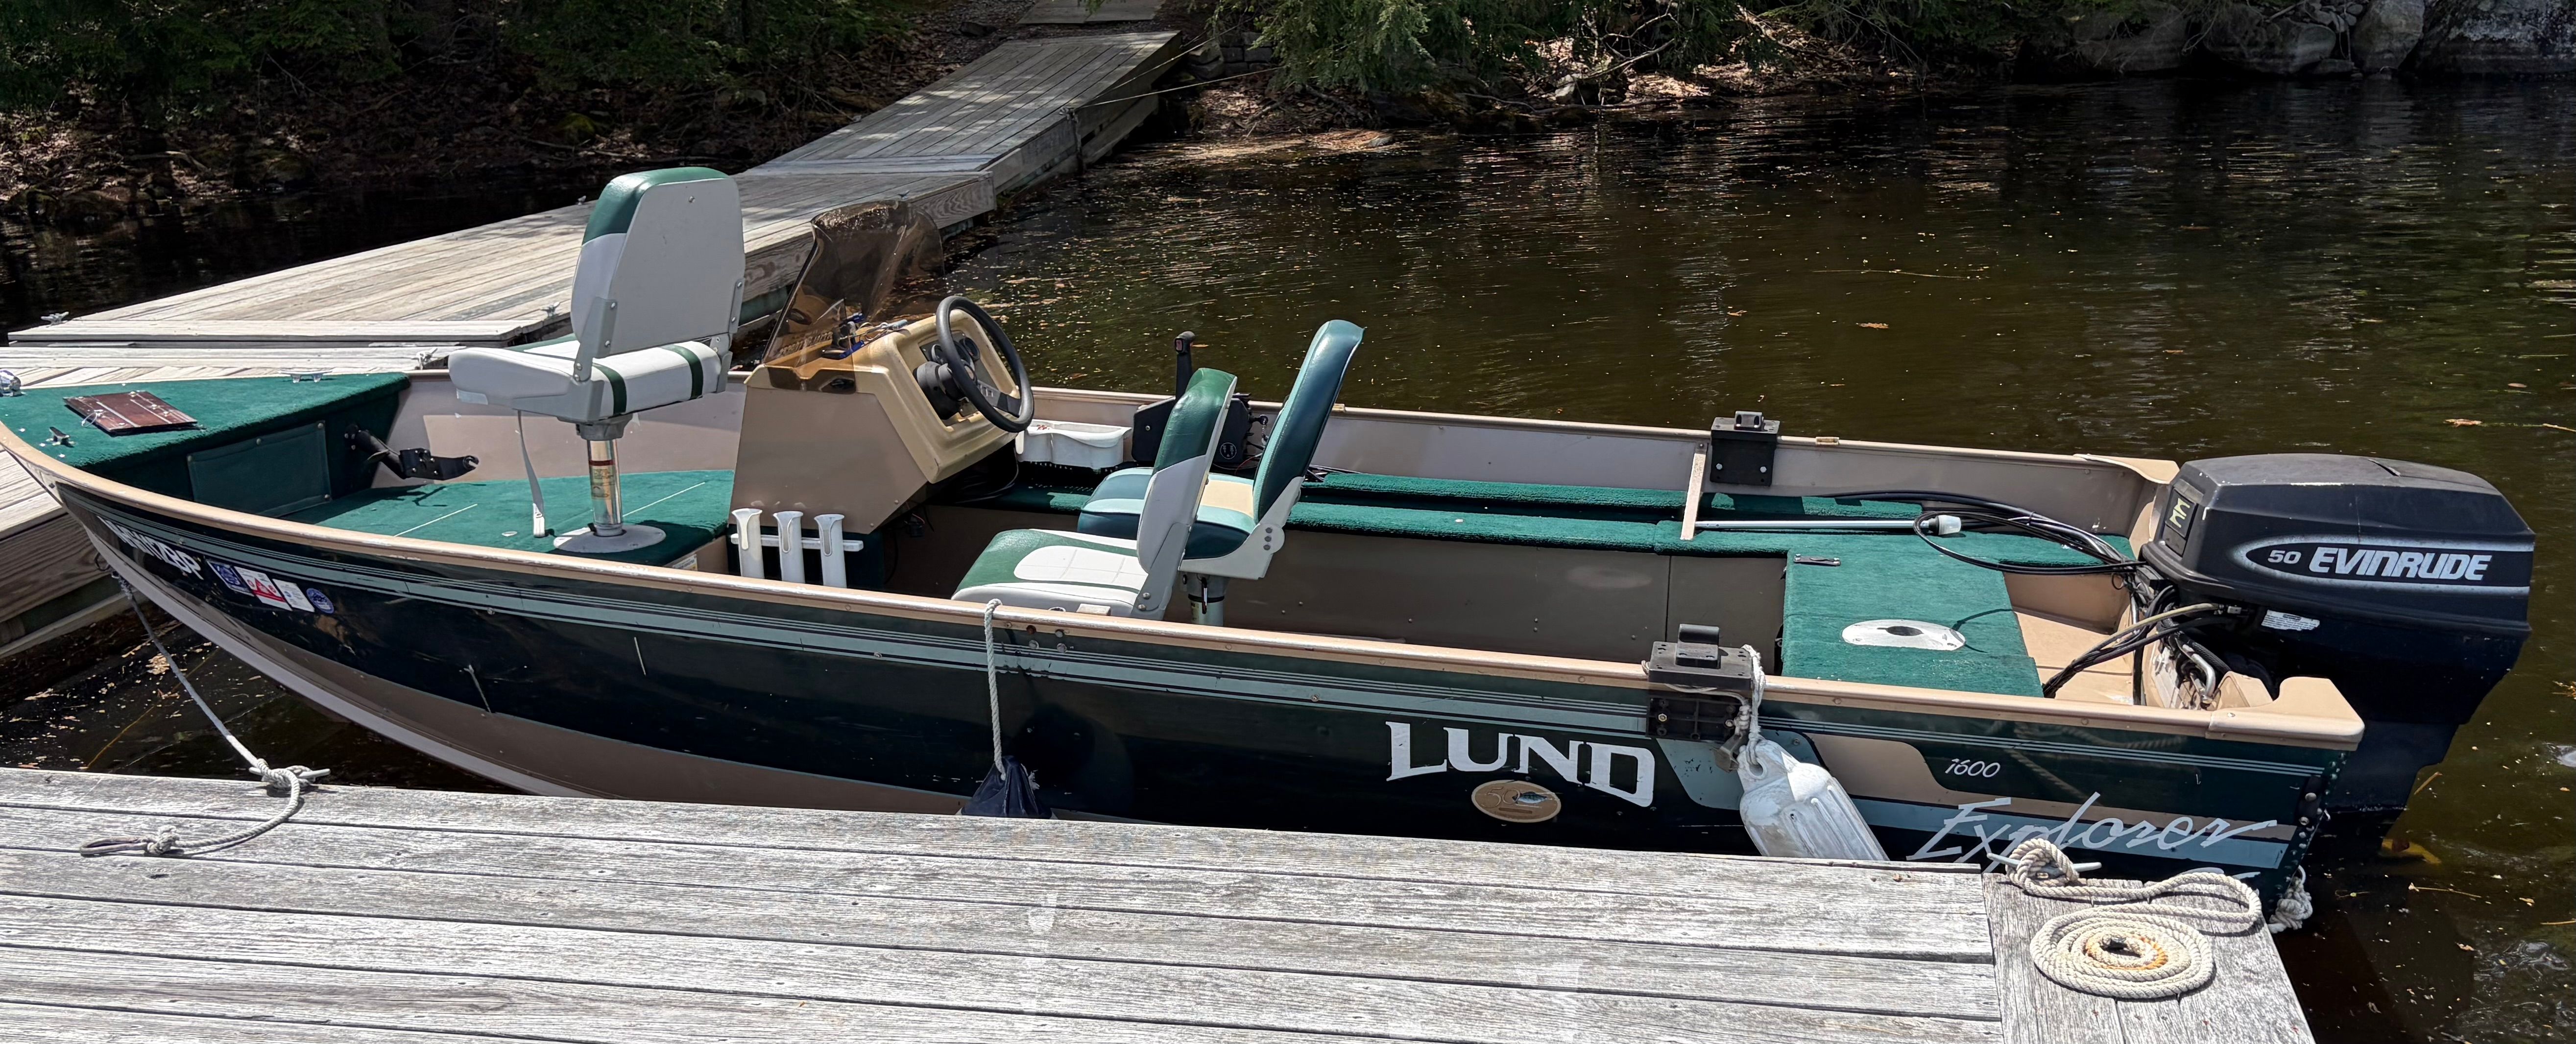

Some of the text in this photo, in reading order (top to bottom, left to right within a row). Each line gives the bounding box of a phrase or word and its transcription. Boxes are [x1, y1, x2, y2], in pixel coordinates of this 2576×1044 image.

[2267, 546, 2493, 581] 50 EVINRUDE
[1385, 721, 1656, 807] LUND
[1945, 758, 2001, 778] 1600
[1481, 786, 1521, 808] 50
[1906, 791, 2278, 874] Explorer
